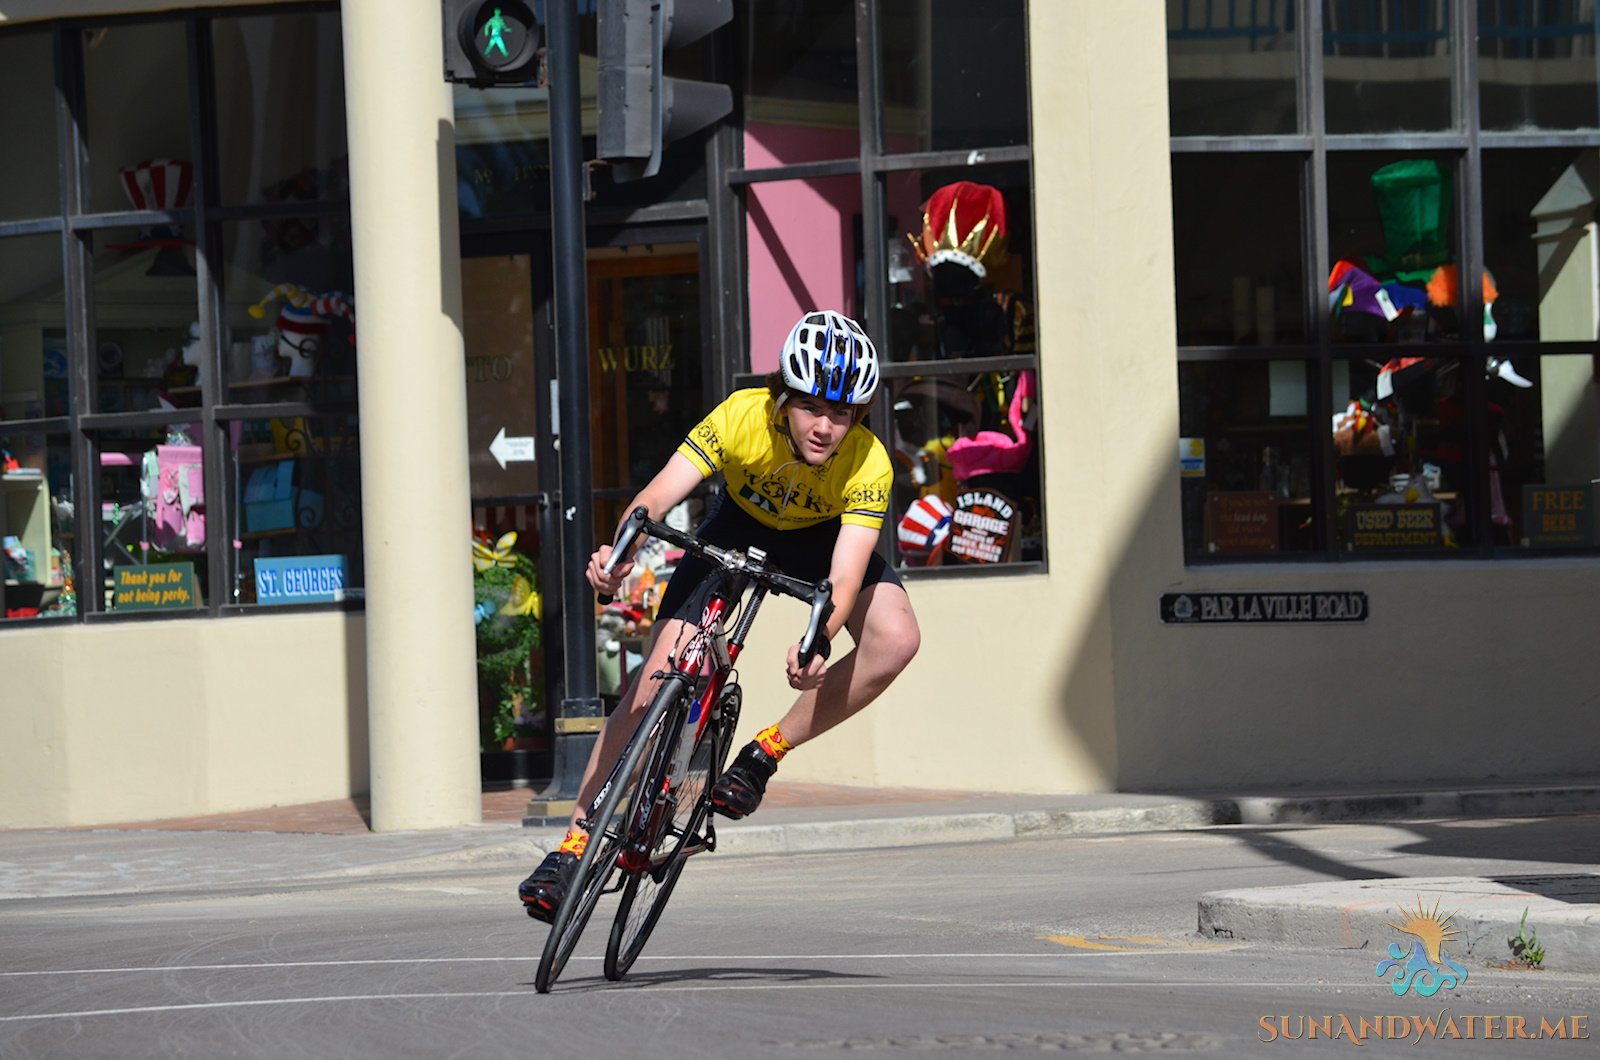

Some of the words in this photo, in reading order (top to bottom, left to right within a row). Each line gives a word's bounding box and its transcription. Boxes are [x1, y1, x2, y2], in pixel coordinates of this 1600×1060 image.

[597, 344, 675, 372] WURZ
[956, 492, 1013, 519] ISLAND
[1531, 490, 1585, 512] FREE
[953, 510, 1009, 535] GARAGE
[1356, 509, 1393, 530] USED
[1397, 508, 1435, 529] BEER
[1354, 531, 1437, 546] DEPARTMENT
[121, 570, 147, 586] Thank
[149, 572, 166, 591] you
[168, 568, 182, 583] for
[258, 569, 282, 597] ST.
[283, 566, 345, 596] GEORGES
[118, 590, 134, 603] not
[136, 588, 161, 606] being
[1200, 595, 1234, 620] PAR
[1315, 595, 1364, 619] ROAD
